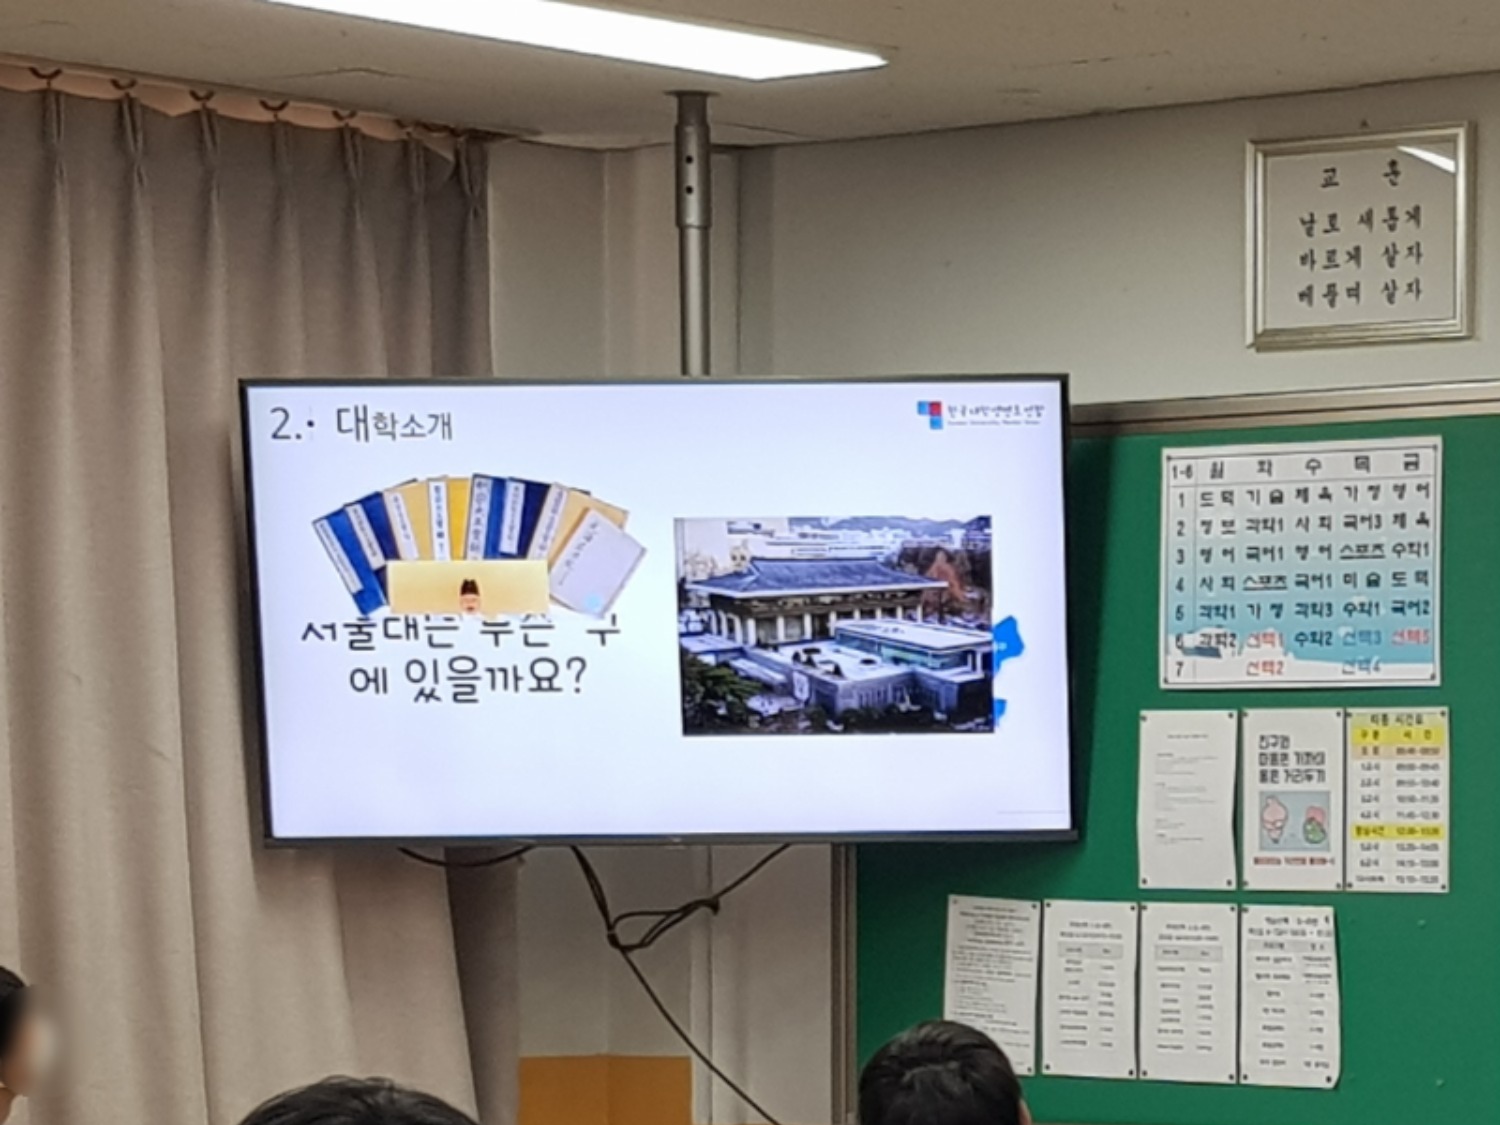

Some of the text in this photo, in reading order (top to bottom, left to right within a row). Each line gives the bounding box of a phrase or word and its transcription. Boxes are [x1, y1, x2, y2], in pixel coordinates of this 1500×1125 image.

[1299, 241, 1423, 271] 바르게 살자
[1381, 277, 1422, 305] 살자
[336, 405, 452, 442] 대학소개
[1209, 461, 1224, 479] 월
[1257, 459, 1272, 477] 화
[1305, 458, 1322, 476] 수
[1354, 455, 1370, 473] 목
[1403, 453, 1419, 471] 금
[349, 656, 587, 703] 에 있을까요?
